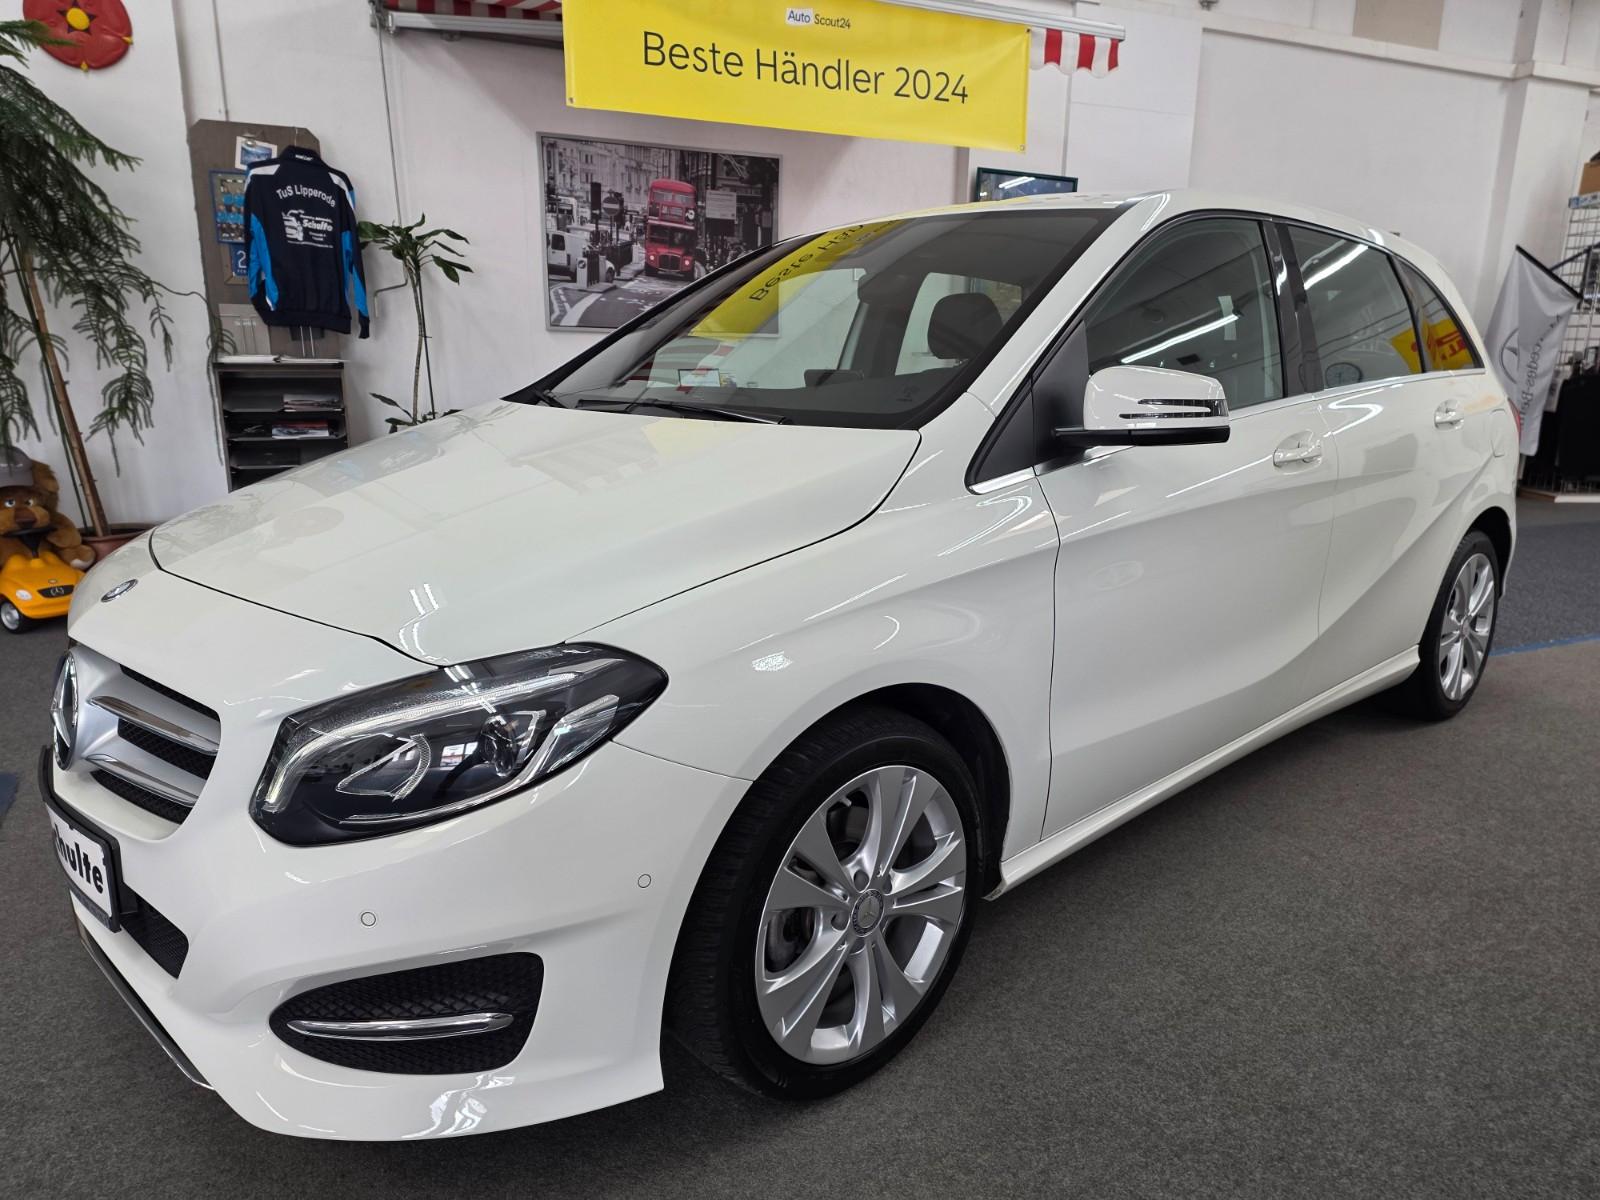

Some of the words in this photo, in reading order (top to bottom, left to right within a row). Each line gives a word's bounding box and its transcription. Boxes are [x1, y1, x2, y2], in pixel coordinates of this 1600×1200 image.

[787, 10, 811, 23] Auto
[814, 14, 851, 29] Scout24
[642, 31, 744, 77] Beste
[755, 49, 885, 95] Händler
[894, 67, 969, 104] 2024
[276, 186, 293, 199] TuS
[294, 185, 336, 207] Lipperode
[54, 822, 104, 894] hulte
